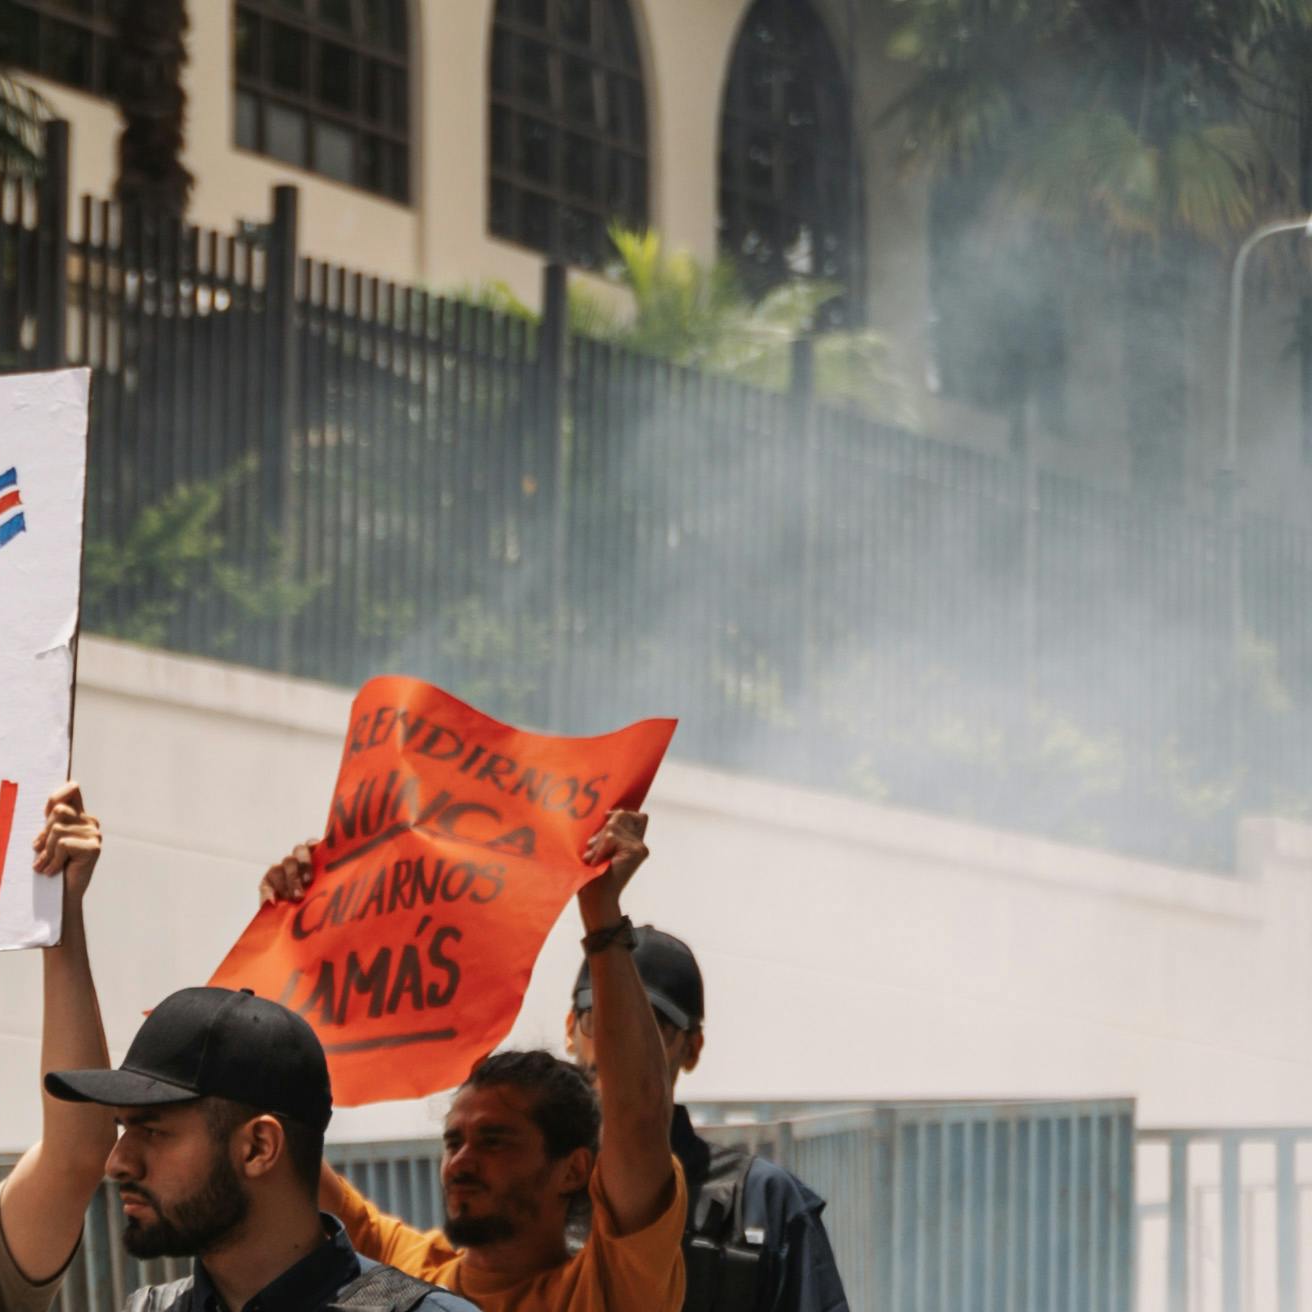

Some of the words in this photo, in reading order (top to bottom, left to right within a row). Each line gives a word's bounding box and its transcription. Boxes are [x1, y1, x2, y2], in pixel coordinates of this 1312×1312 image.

[348, 706, 609, 821] RENDIRNOS
[326, 769, 537, 857] NUNCA
[291, 855, 507, 941] CALLARNOS
